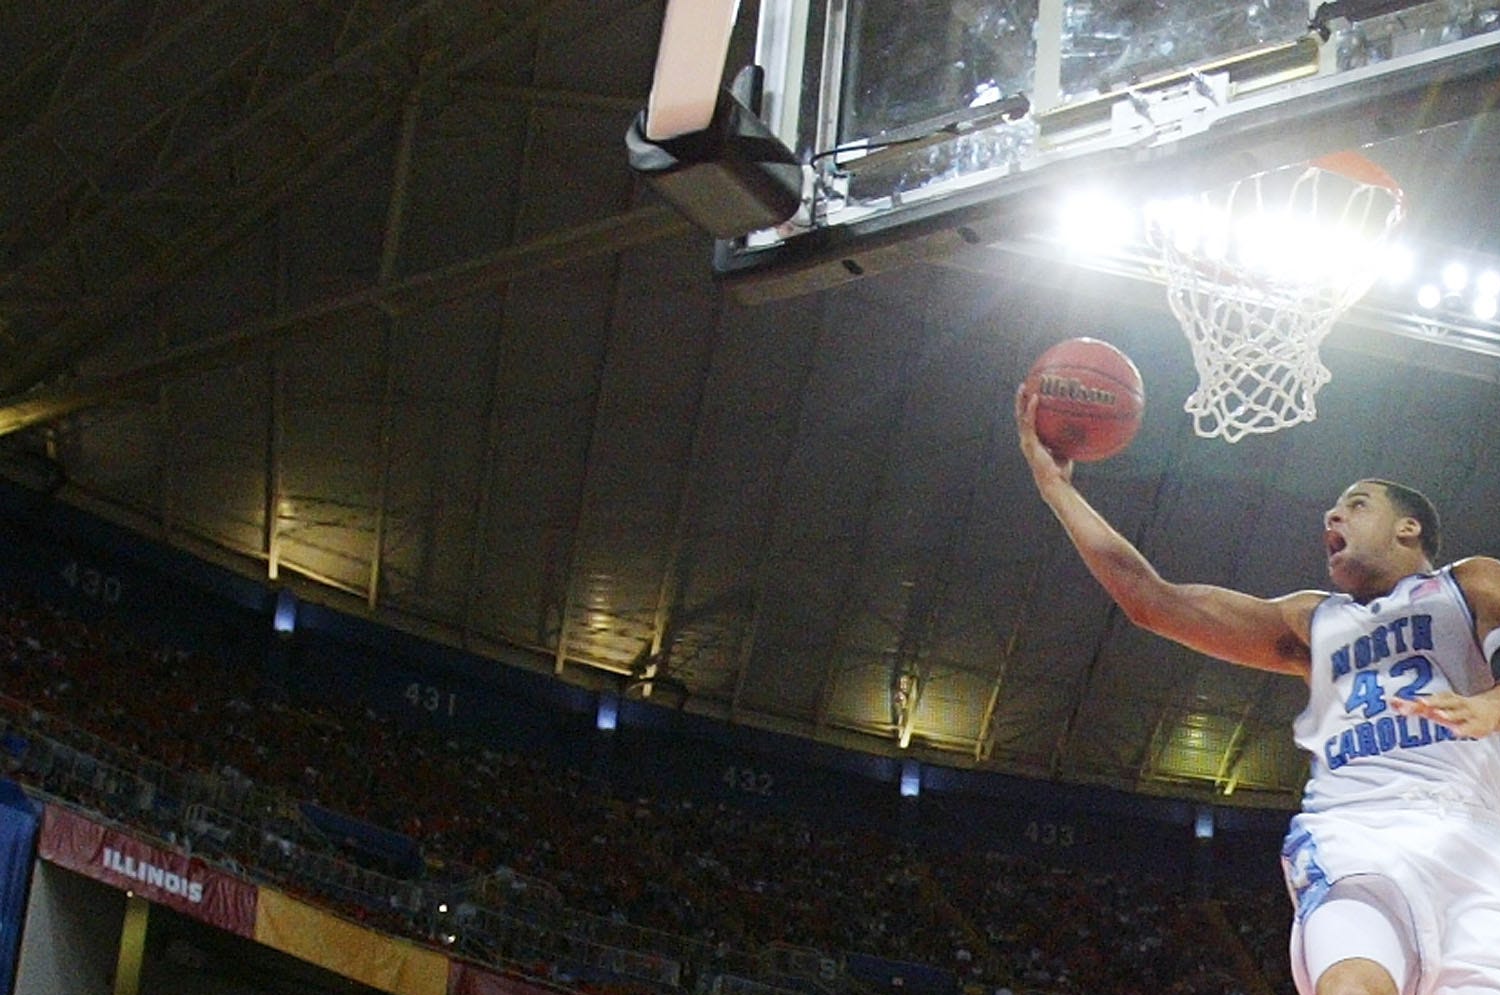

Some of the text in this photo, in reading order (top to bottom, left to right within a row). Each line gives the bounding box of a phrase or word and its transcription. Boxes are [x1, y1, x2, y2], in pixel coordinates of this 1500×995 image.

[1040, 373, 1116, 405] Wilson
[1331, 614, 1433, 683] NORTH
[404, 683, 454, 716] 431
[1344, 655, 1433, 719] 42
[1324, 714, 1478, 771] CAROLI
[724, 766, 773, 794] 432
[103, 848, 203, 904] ILLINOIS
